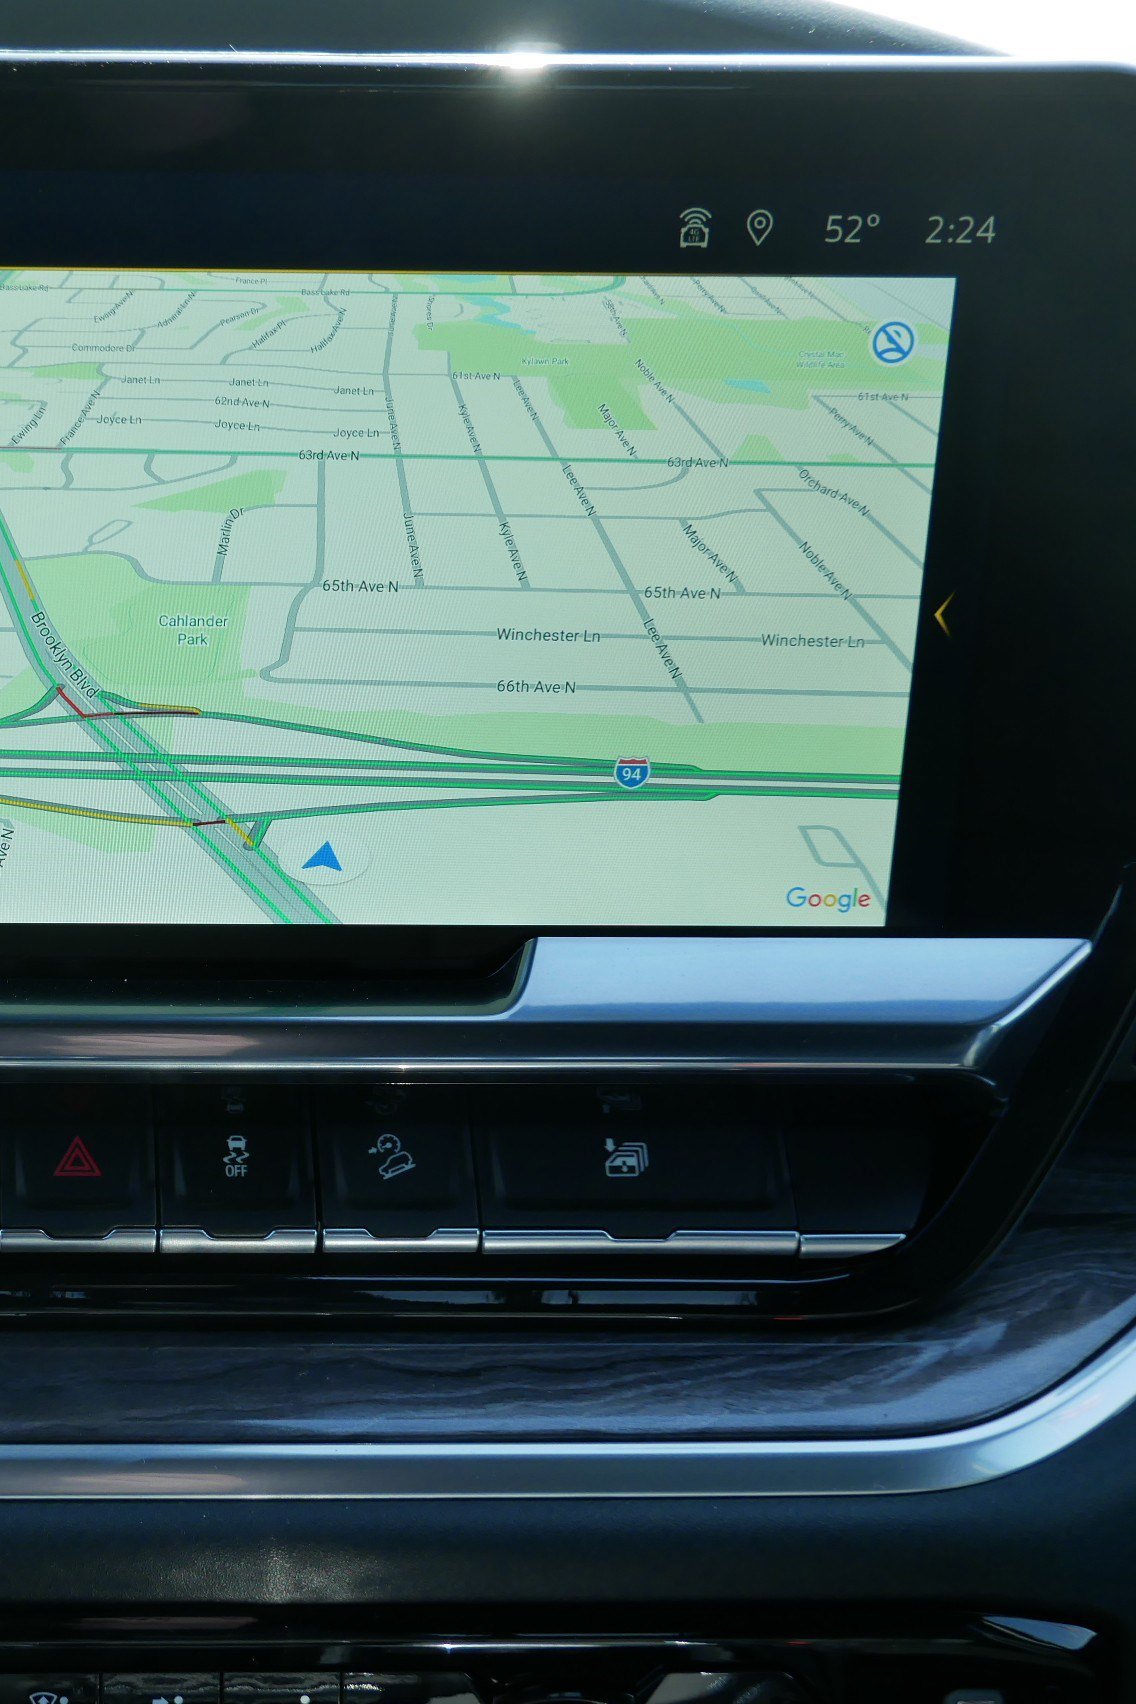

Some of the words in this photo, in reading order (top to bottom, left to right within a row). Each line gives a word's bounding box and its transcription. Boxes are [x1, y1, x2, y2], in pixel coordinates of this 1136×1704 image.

[825, 214, 880, 243] 52°
[925, 216, 997, 243] 2:24
[320, 288, 336, 296] Lake
[220, 310, 250, 326] Pearson
[250, 307, 260, 316] Dr
[252, 326, 278, 348] Halifax
[72, 343, 124, 352] Commodore
[126, 344, 136, 352] Dr
[522, 357, 549, 366] Kylawn
[551, 357, 569, 366] Park
[121, 375, 148, 384] Janet
[150, 376, 161, 384] Ln
[229, 377, 255, 388] Janet
[258, 378, 269, 388] Ln
[452, 372, 472, 380] 61st
[475, 372, 491, 380] Ave
[493, 372, 500, 380] N
[634, 358, 656, 384] Noble
[652, 380, 670, 398] Ave
[666, 394, 676, 404] N
[334, 386, 360, 396] Janet
[363, 386, 374, 396] Ln
[514, 380, 527, 397] Lee
[214, 396, 240, 406] 62nd
[241, 398, 260, 408] Ave
[262, 399, 270, 408] N
[858, 392, 880, 401] 61st
[882, 393, 898, 402] Ave
[900, 393, 909, 402] N
[96, 414, 127, 426] Joyce
[130, 415, 142, 424] Ln
[458, 404, 474, 425] Kyle
[12, 419, 36, 445] Ewing
[34, 406, 46, 420] Ln
[61, 418, 82, 446] France
[80, 400, 96, 420] Ave
[214, 420, 245, 432] Joyce
[248, 422, 260, 432] Ln
[598, 402, 618, 431] Major
[614, 426, 632, 450] Ave
[628, 446, 637, 457] N
[333, 428, 364, 440] Joyce
[367, 428, 380, 438] Ln
[465, 423, 480, 444] Ave
[298, 450, 324, 460] 63rd
[326, 451, 348, 461] Ave
[351, 451, 360, 461] N
[667, 457, 692, 468] 63rd
[694, 458, 718, 468] Ave
[720, 458, 729, 468] N
[562, 464, 577, 486] Lee
[573, 482, 590, 508] Ave
[586, 504, 597, 518] N
[799, 468, 839, 498] Orchard
[838, 492, 861, 510] Ave
[860, 505, 870, 516] N
[216, 518, 234, 556] Marlin
[230, 506, 245, 520] Dr
[403, 512, 416, 543] June
[409, 544, 420, 570] Ave
[498, 521, 514, 550] Kyle
[508, 548, 524, 573] Ave
[518, 570, 528, 582] N
[683, 524, 710, 556] Major
[706, 552, 730, 576] Ave
[727, 570, 738, 584] N
[414, 568, 424, 578] N
[799, 540, 827, 574] Noble
[824, 568, 846, 594] Ave
[842, 588, 854, 601] N
[322, 580, 354, 592] 65th
[358, 580, 384, 592] Ave
[388, 581, 399, 593] N
[644, 586, 676, 599] 65th
[680, 588, 706, 600] Ave
[710, 588, 721, 600] N
[158, 614, 228, 628] Cahlander
[178, 633, 208, 646] Park
[496, 628, 579, 643] Winchester
[582, 628, 601, 644] Ln
[761, 633, 843, 649] Winchester
[848, 634, 865, 649] Ln
[31, 611, 72, 671] Brooklyn
[70, 668, 100, 698] Blvd
[643, 618, 661, 643] Lee
[656, 640, 676, 668] Ave
[670, 665, 683, 680] N
[497, 680, 530, 694] 66th
[534, 681, 562, 694] Ave
[565, 681, 576, 694] N
[622, 768, 642, 781] 94
[1, 828, 14, 842] N
[786, 886, 872, 913] Google
[225, 1164, 248, 1178] OFF
